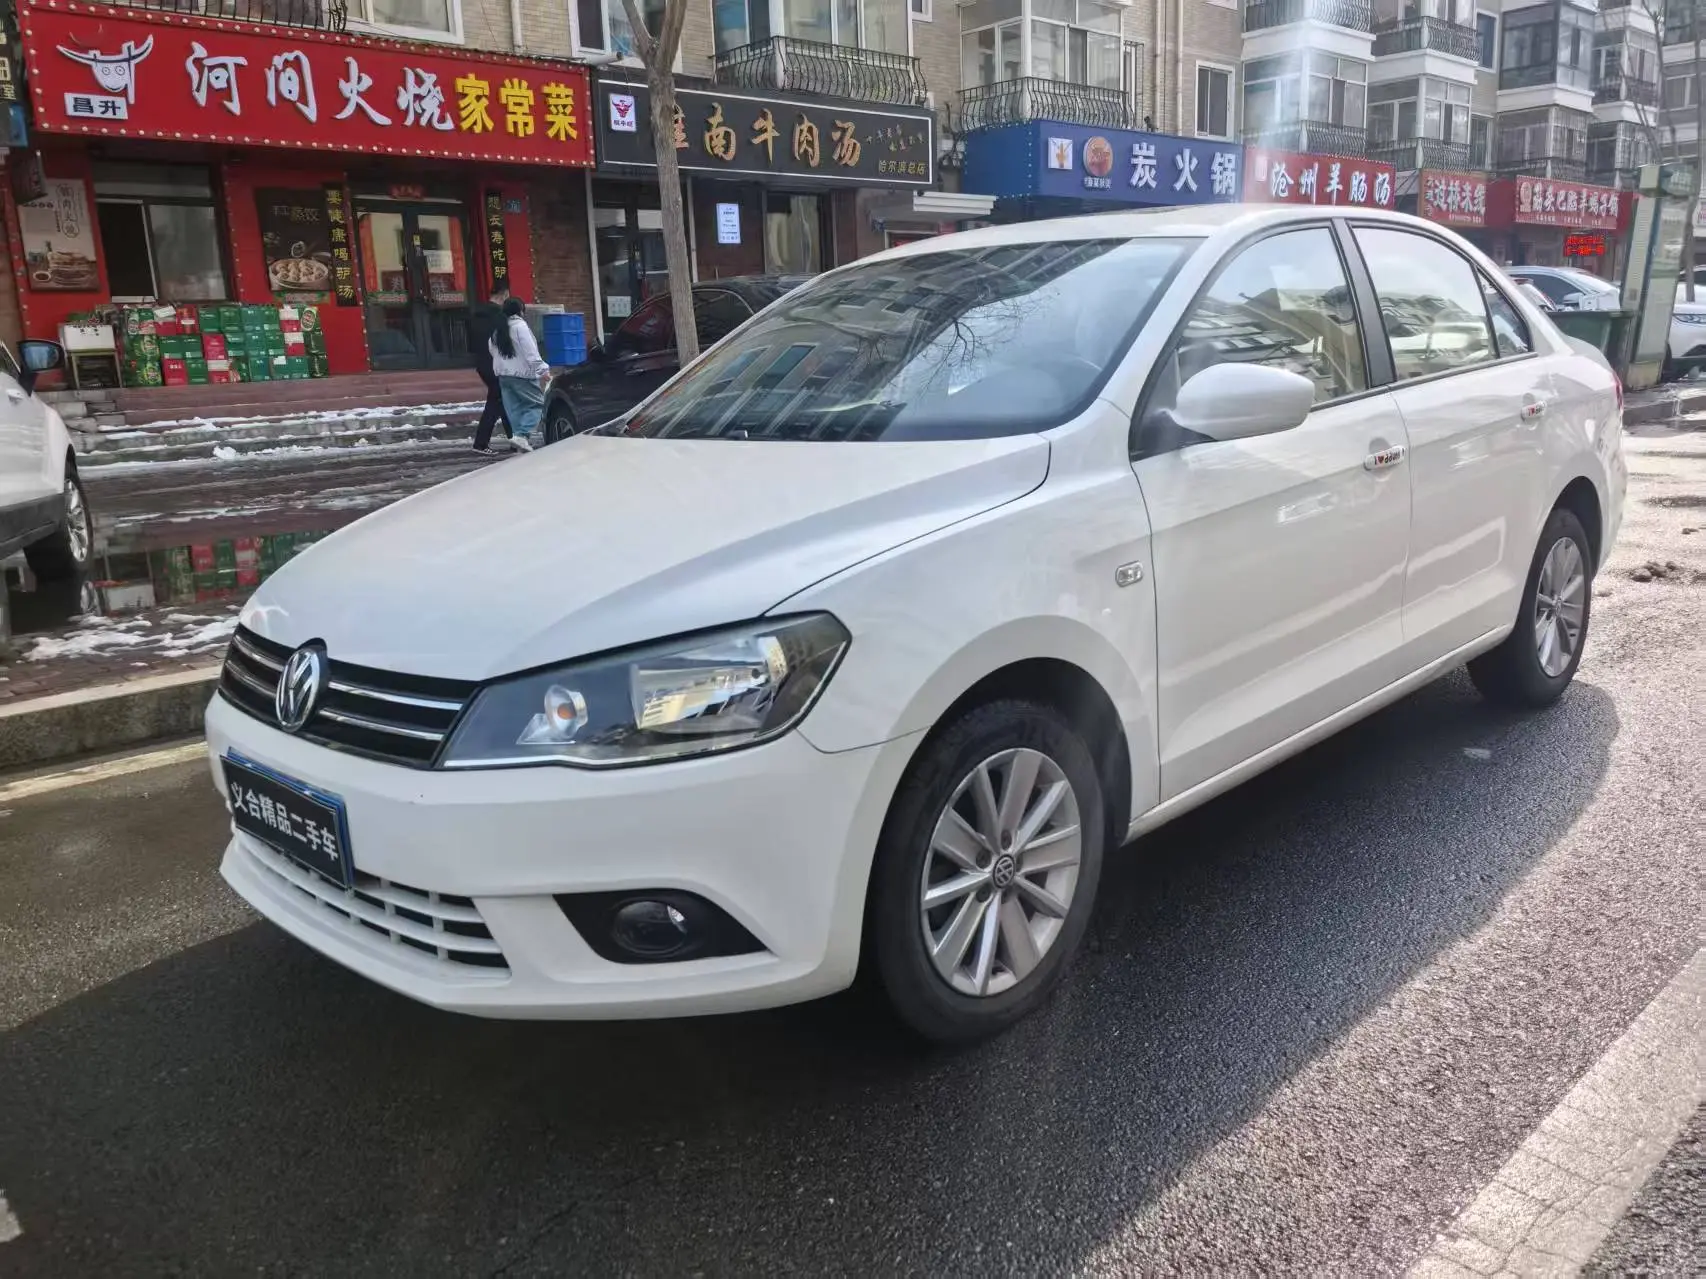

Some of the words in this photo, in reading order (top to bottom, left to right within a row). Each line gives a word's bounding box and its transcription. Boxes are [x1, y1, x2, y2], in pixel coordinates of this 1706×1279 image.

[72, 95, 124, 117] 昌升
[187, 41, 455, 131] 河间火烧
[455, 73, 578, 141] 家常菜
[1129, 142, 1237, 195] 炭火锅
[1271, 161, 1391, 206] 沧州羊肠汤
[326, 189, 354, 299] 要健康喝驴汤
[231, 781, 339, 861] 义合精品二手车
